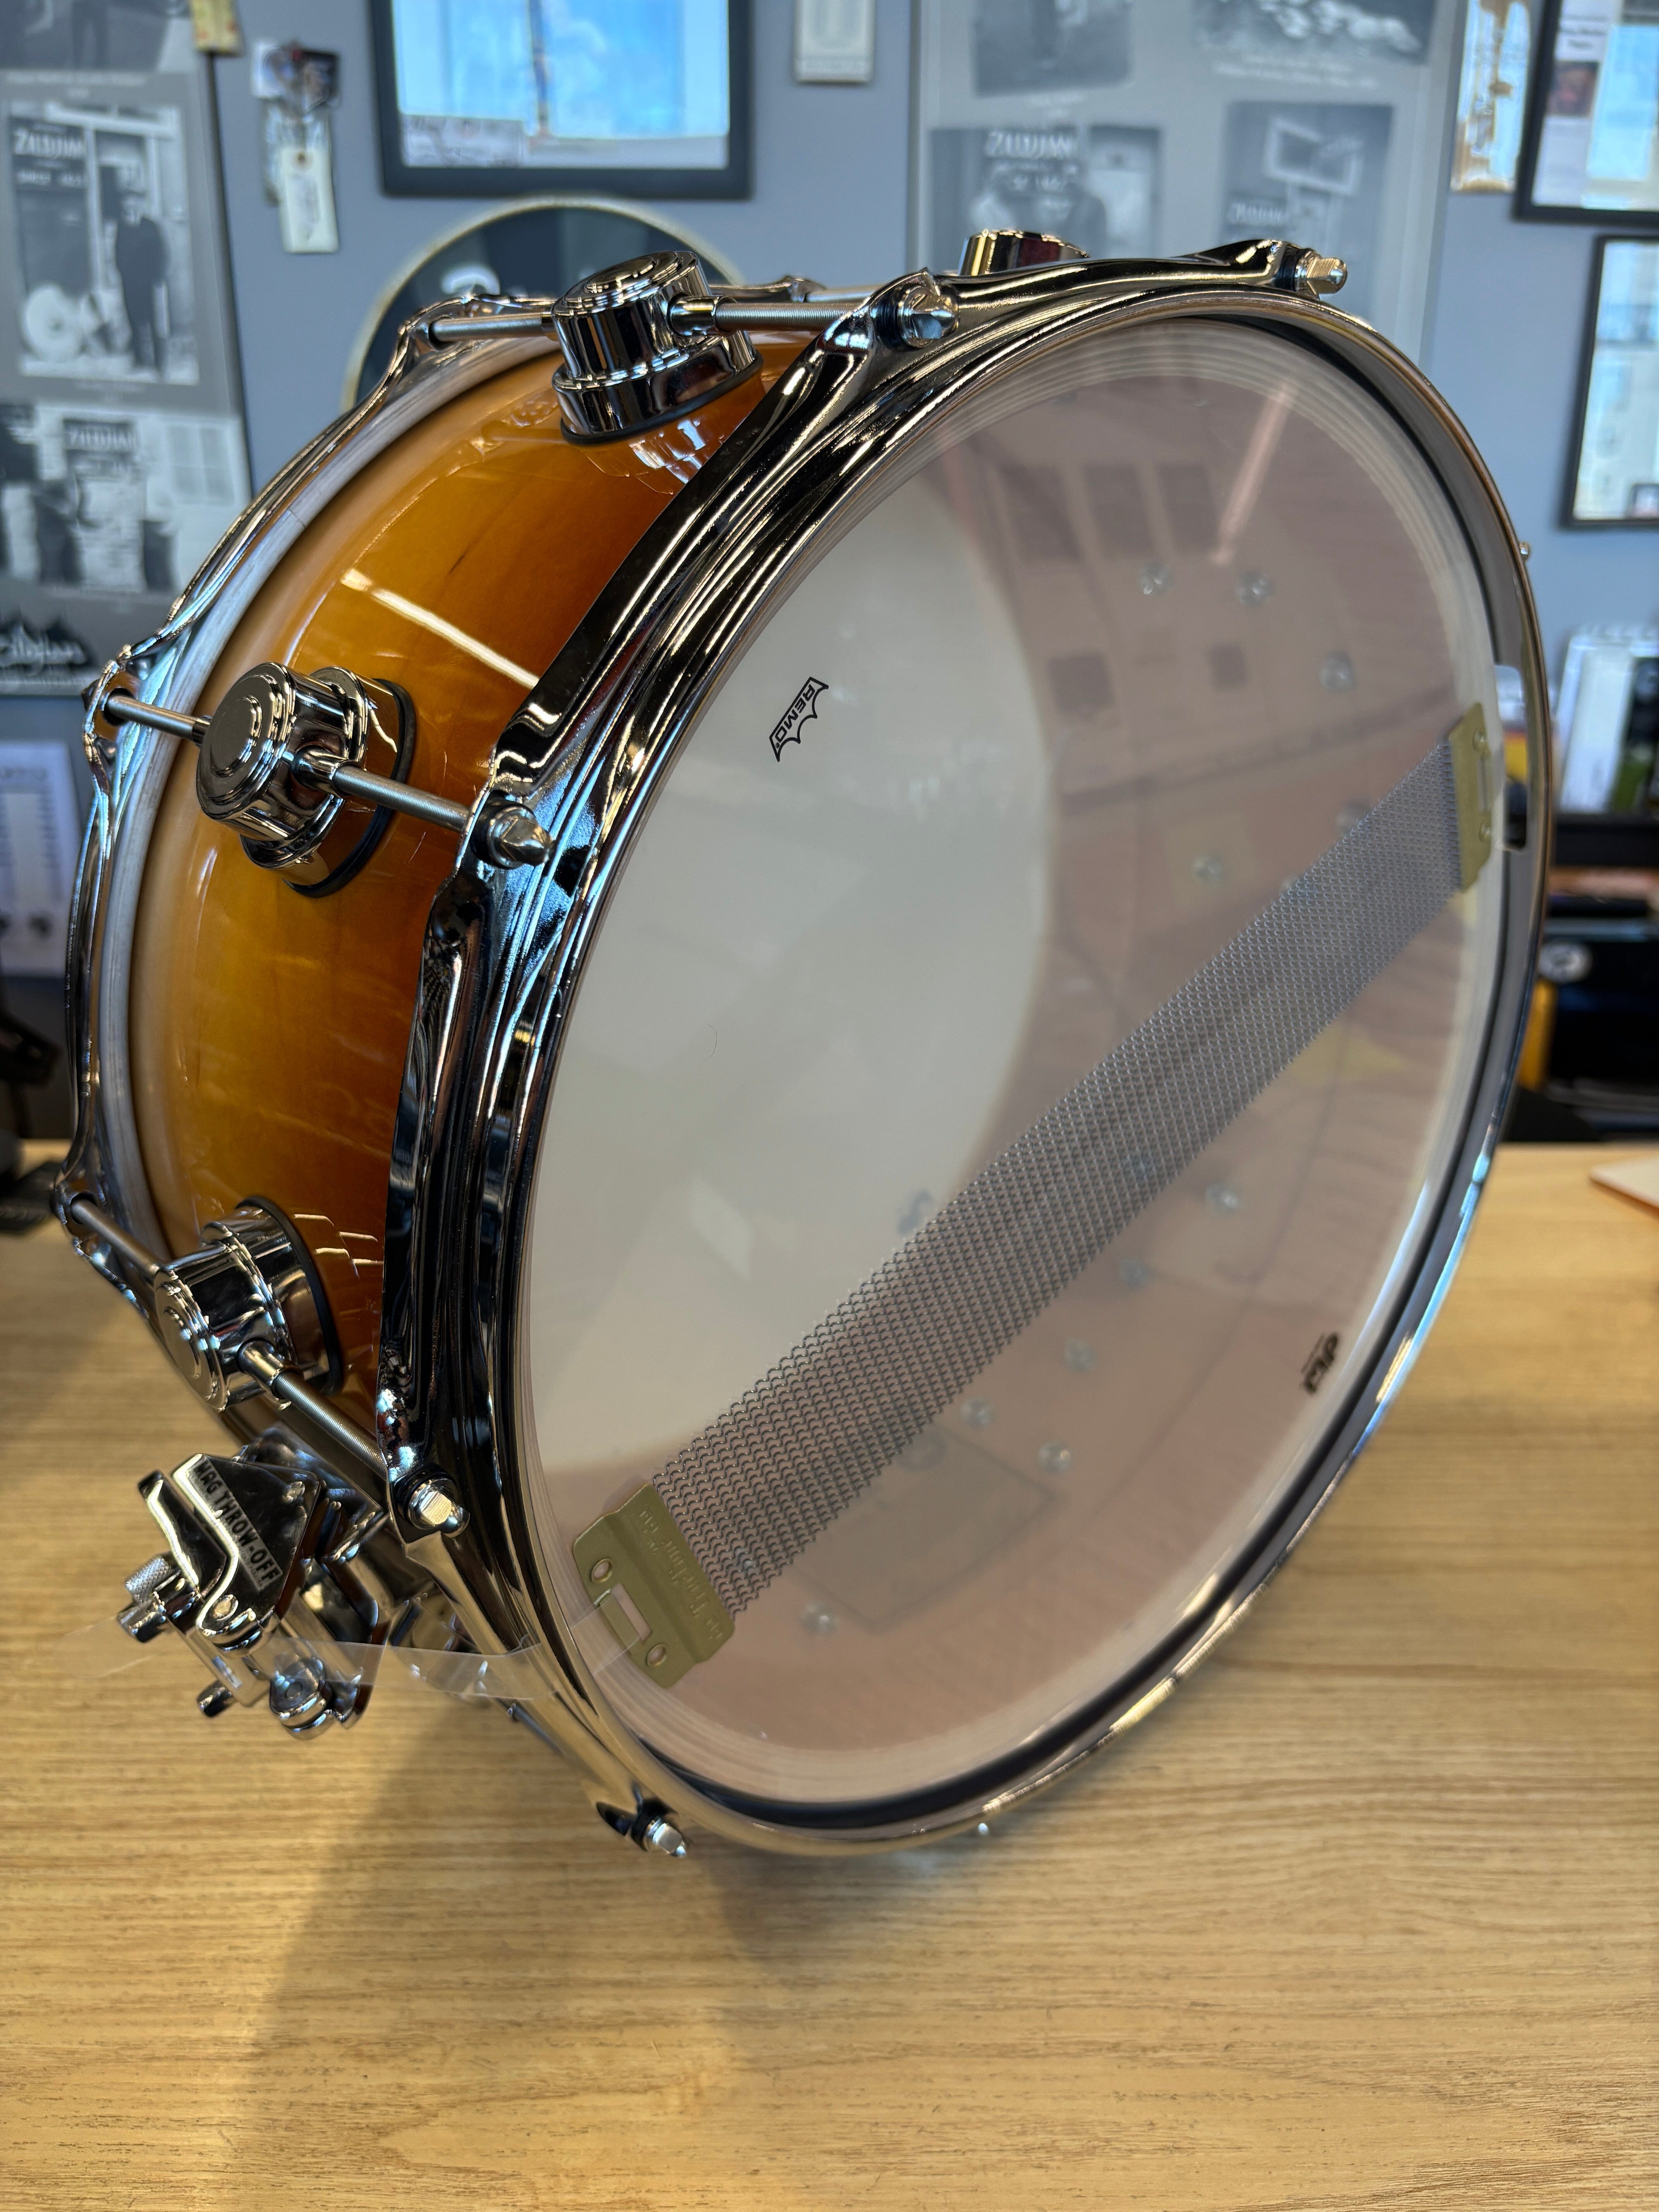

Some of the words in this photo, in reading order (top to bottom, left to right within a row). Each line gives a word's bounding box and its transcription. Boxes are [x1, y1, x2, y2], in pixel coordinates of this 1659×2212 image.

[775, 684, 816, 743] REMO
[194, 1460, 222, 1493] MAG
[214, 1491, 280, 1581] THROW-OFF
